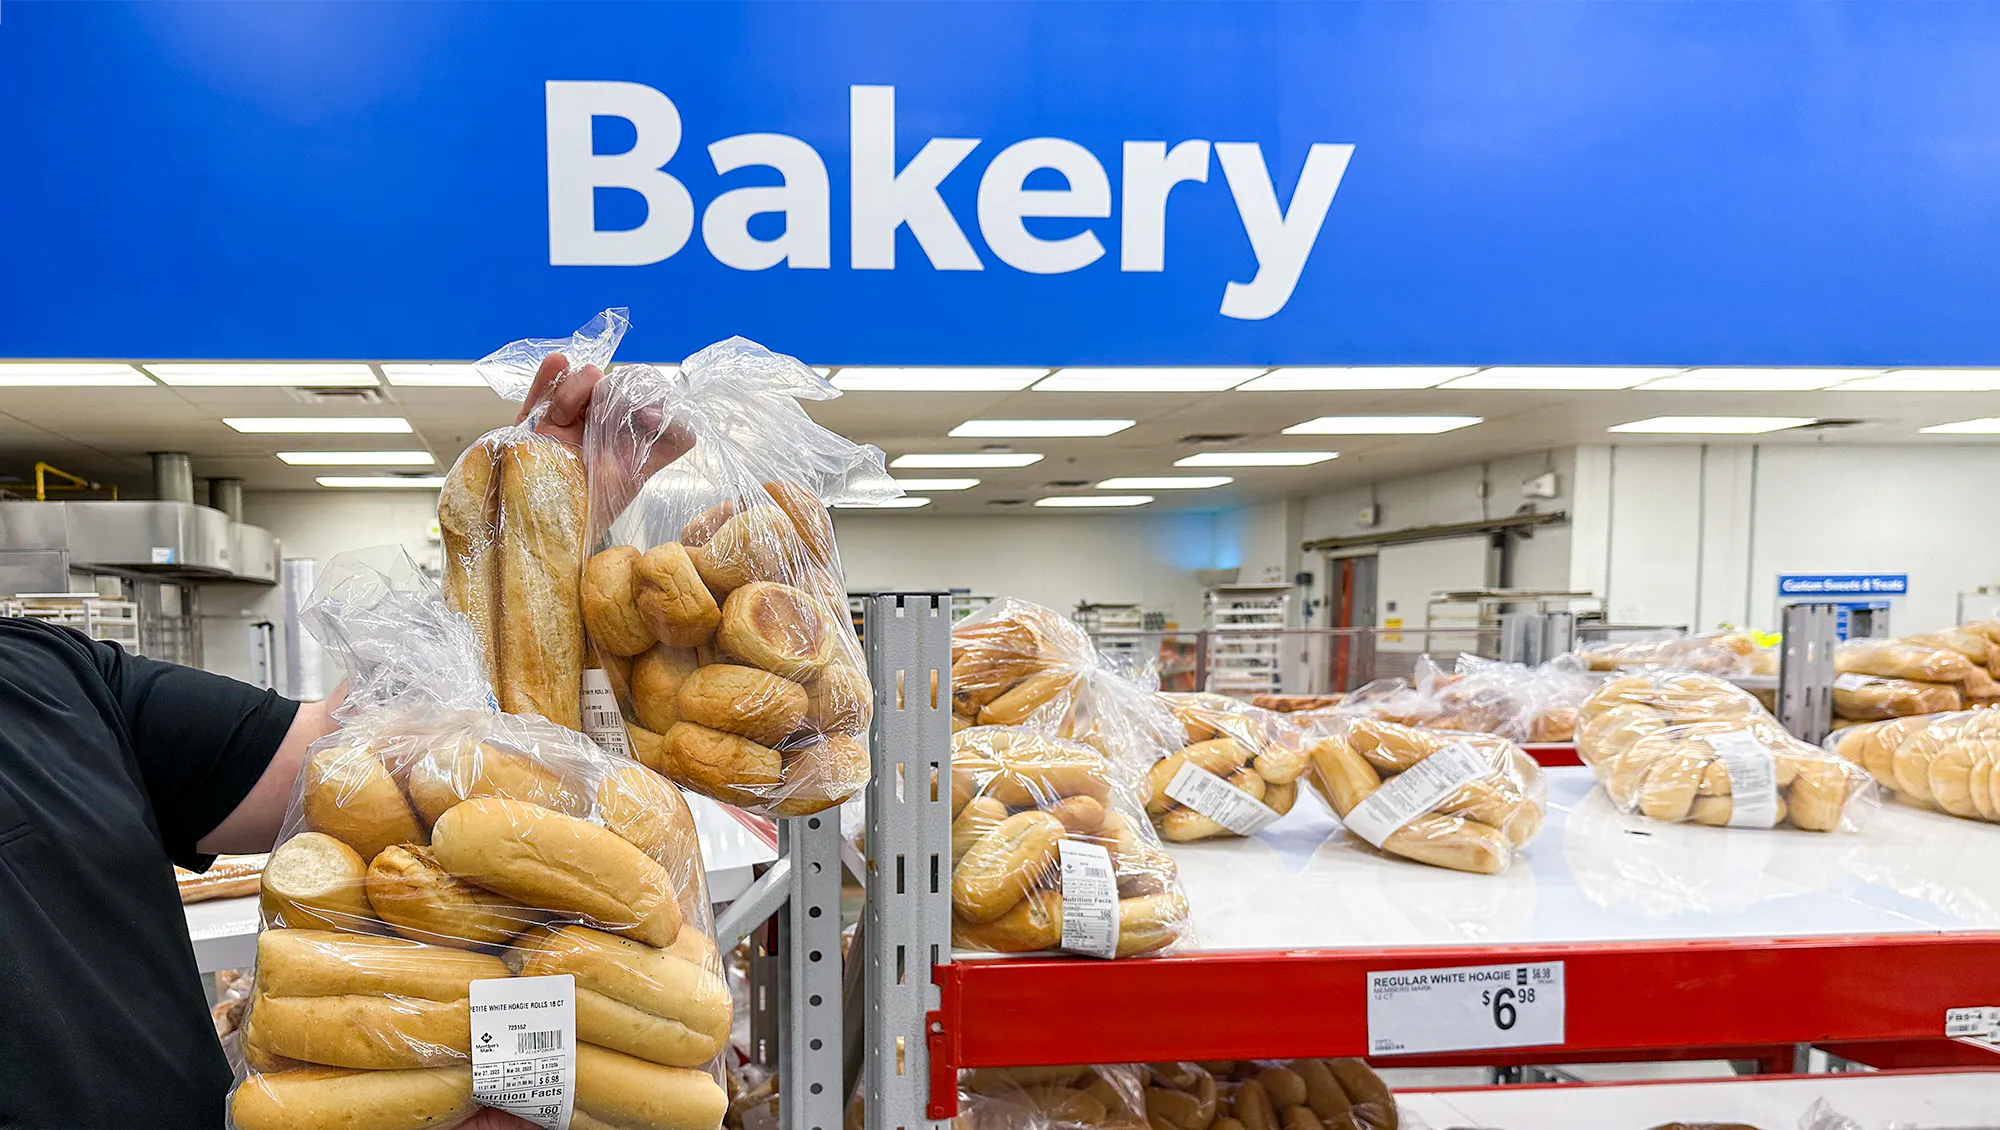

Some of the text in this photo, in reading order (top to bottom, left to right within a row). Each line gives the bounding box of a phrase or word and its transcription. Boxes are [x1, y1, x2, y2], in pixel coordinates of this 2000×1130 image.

[545, 80, 1356, 320] Bakery
[1374, 975, 1427, 987] REGULAR
[1431, 973, 1465, 984] WHITE
[1469, 970, 1511, 982] HOAGIE
[489, 1003, 507, 1012] WHITE
[508, 1002, 529, 1011] HOAGIE
[531, 1001, 548, 1009] ROLLS
[557, 999, 564, 1007] CT
[531, 1088, 562, 1098] Facts
[539, 1106, 559, 1115] 160
